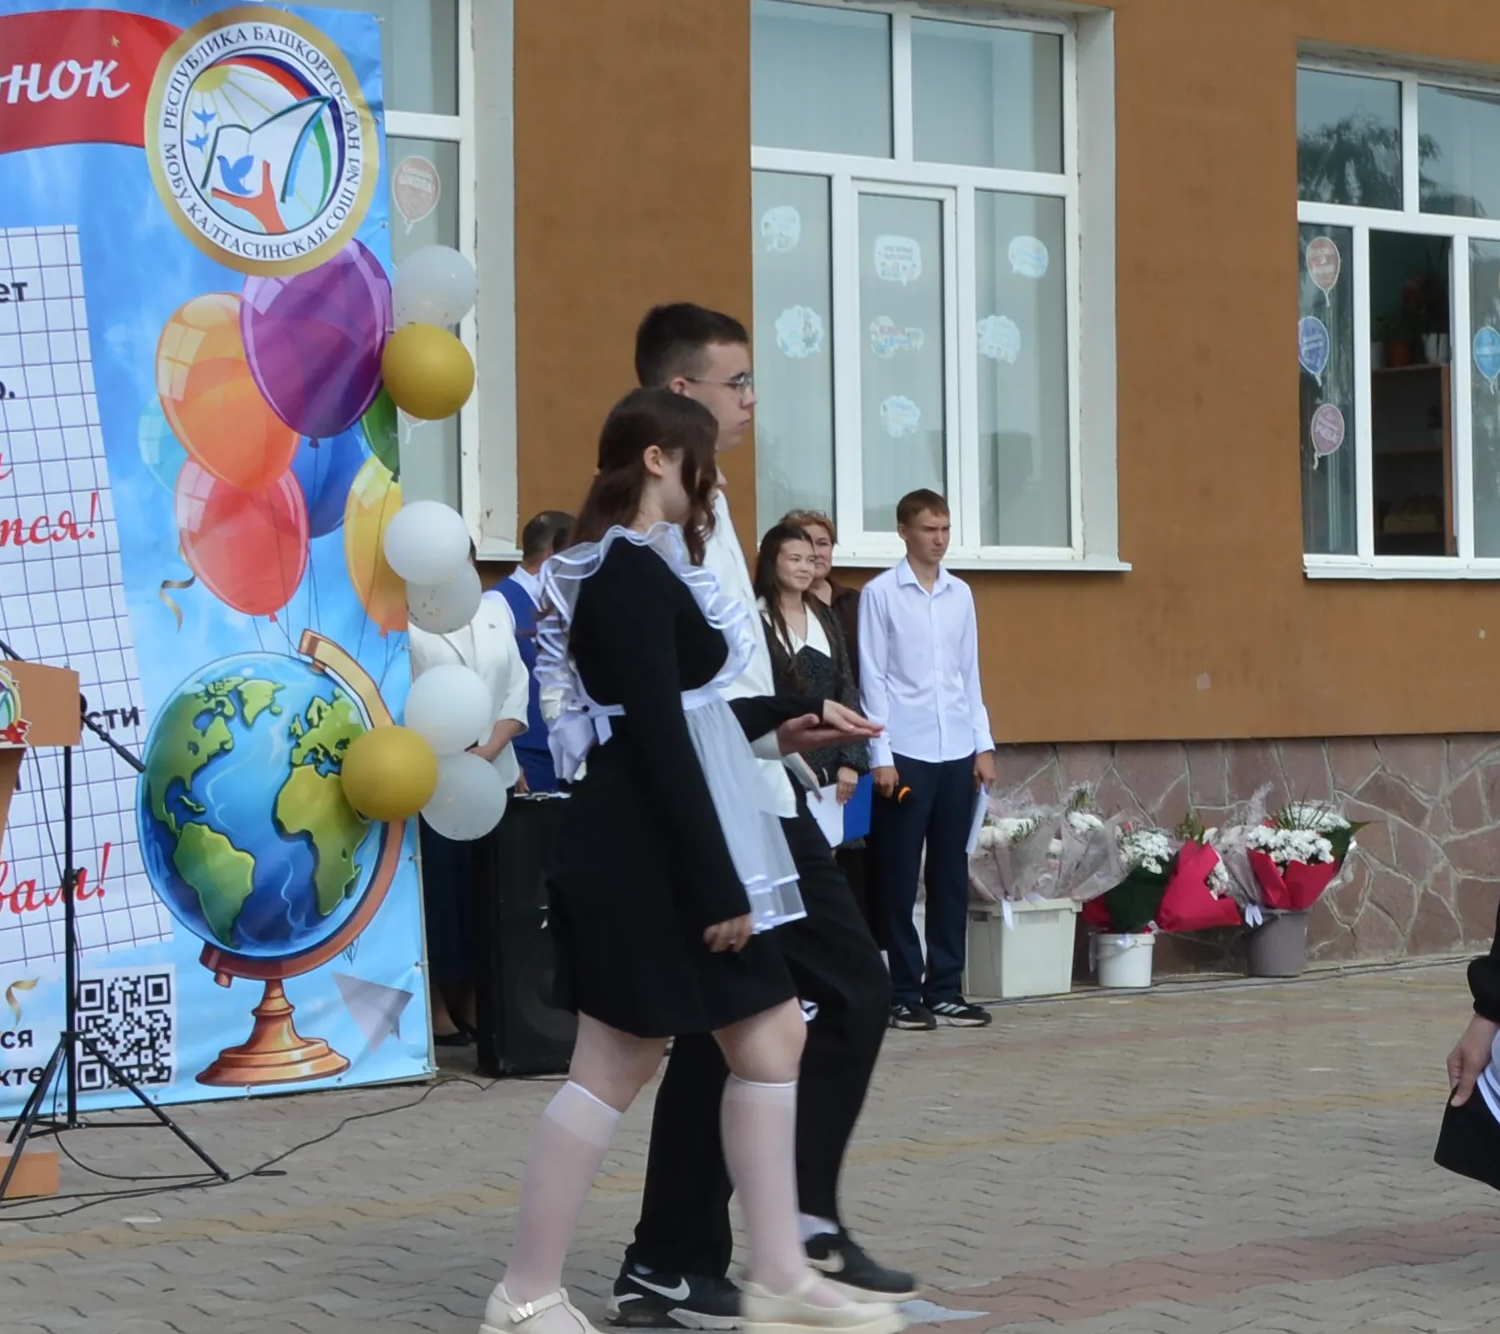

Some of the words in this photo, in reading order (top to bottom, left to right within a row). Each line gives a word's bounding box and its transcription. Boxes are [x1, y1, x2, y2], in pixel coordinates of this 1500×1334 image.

[163, 27, 248, 130] РЕСПУБЛИКА
[163, 143, 193, 200] МОБУ
[186, 200, 329, 258] КАЛТАСИНСКАЯ
[326, 186, 357, 230] СОШ
